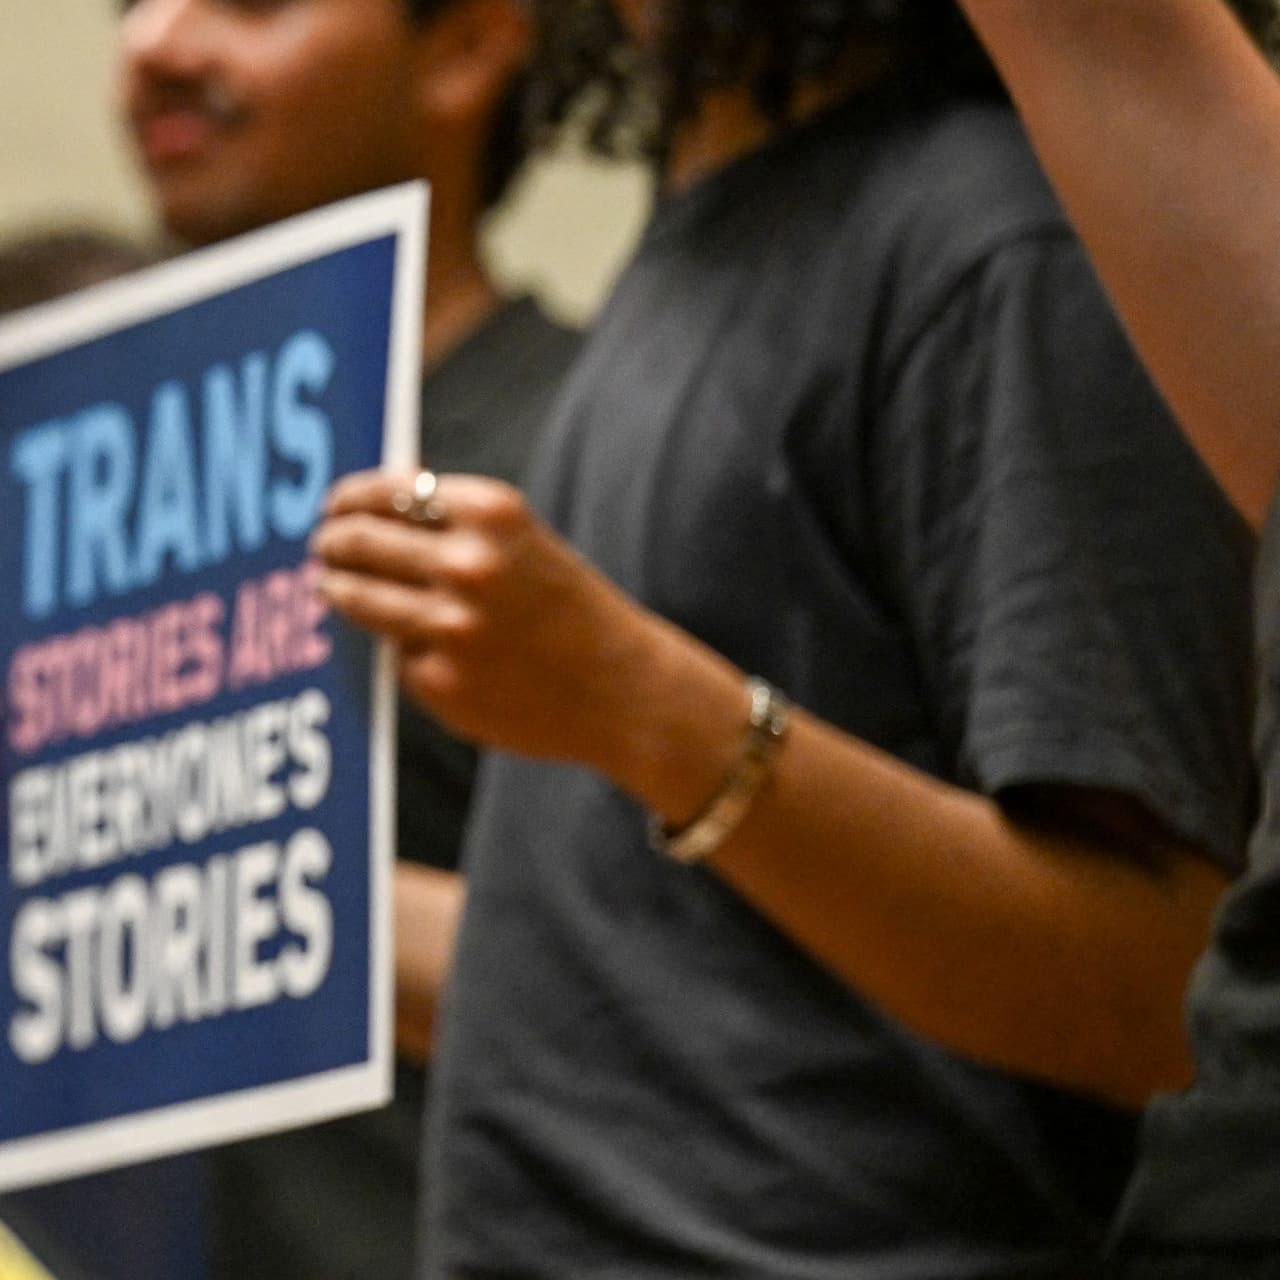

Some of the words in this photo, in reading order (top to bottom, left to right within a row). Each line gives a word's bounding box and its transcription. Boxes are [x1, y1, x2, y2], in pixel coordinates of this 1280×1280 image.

[10, 328, 336, 618] TRANS
[8, 592, 225, 754] STORIES
[230, 560, 333, 688] ARE
[7, 827, 333, 1065] STORIES
